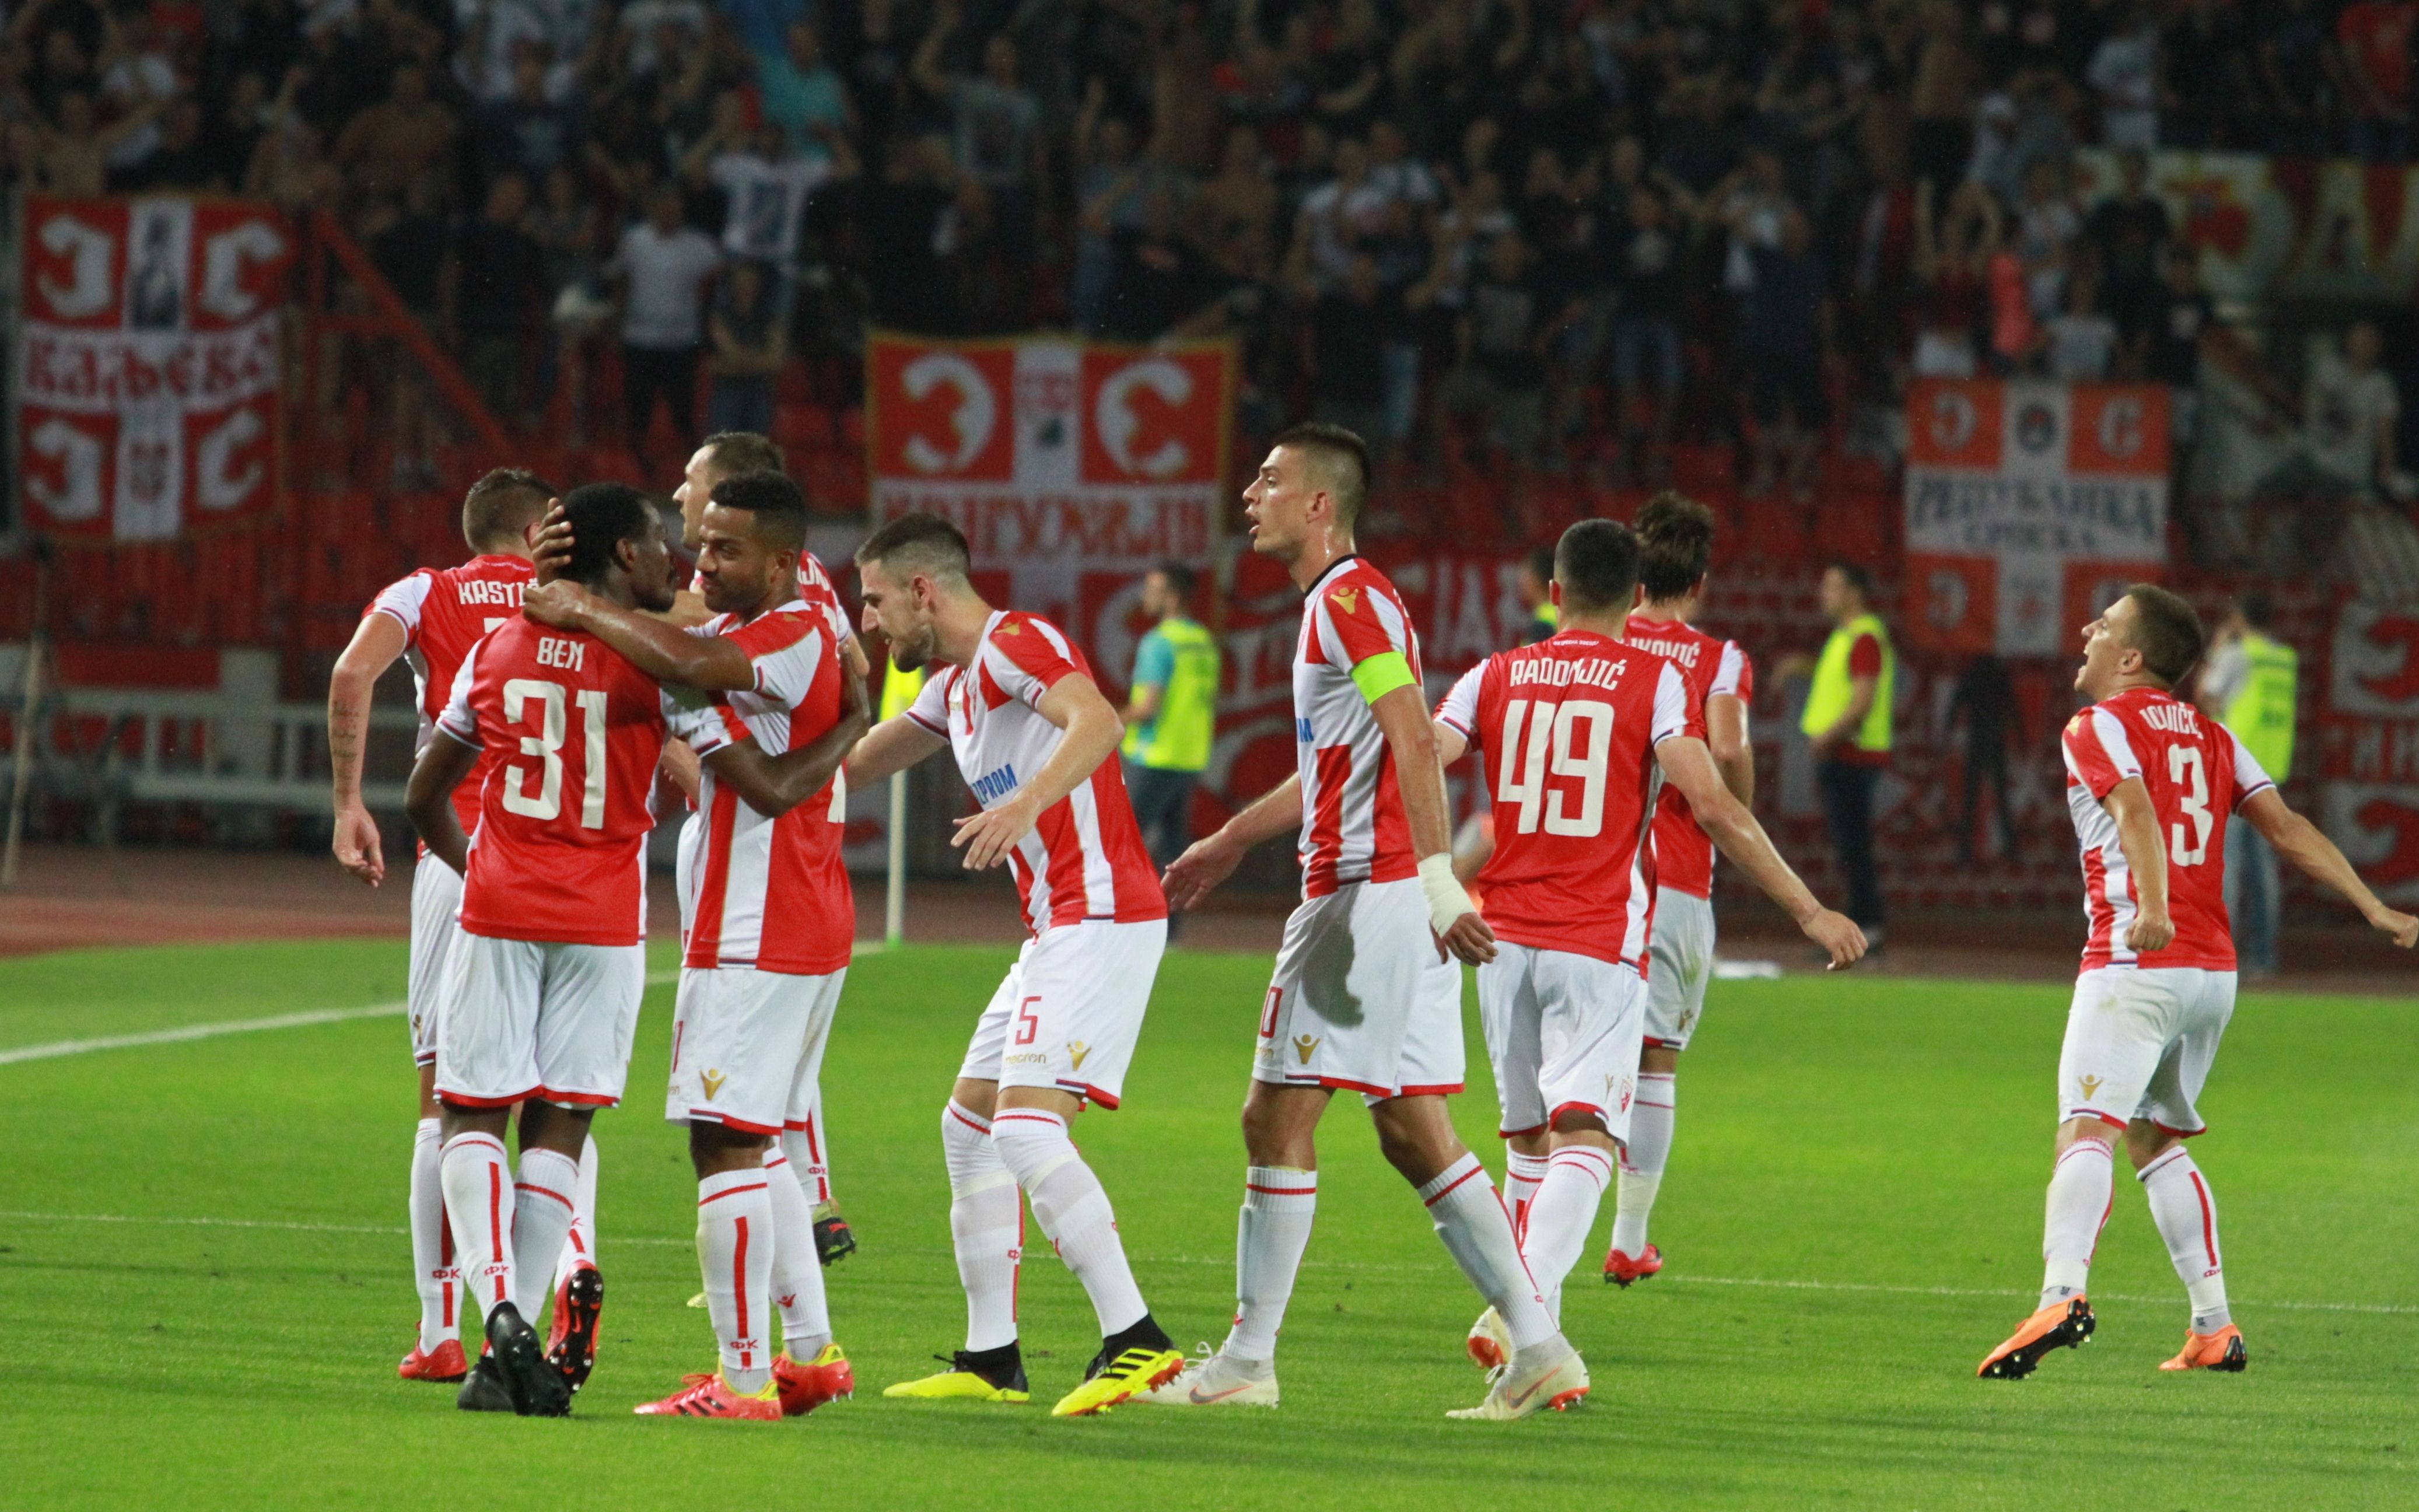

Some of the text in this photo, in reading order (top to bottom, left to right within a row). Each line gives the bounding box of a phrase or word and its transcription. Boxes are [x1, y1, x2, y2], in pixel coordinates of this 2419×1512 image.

[536, 636, 586, 672] BEN
[502, 678, 608, 830] 31
[1497, 699, 1615, 838] 49
[970, 763, 1018, 804] ZPROM
[2168, 743, 2214, 867] 3
[1015, 995, 1042, 1046] 5
[432, 1268, 461, 1279] ФК
